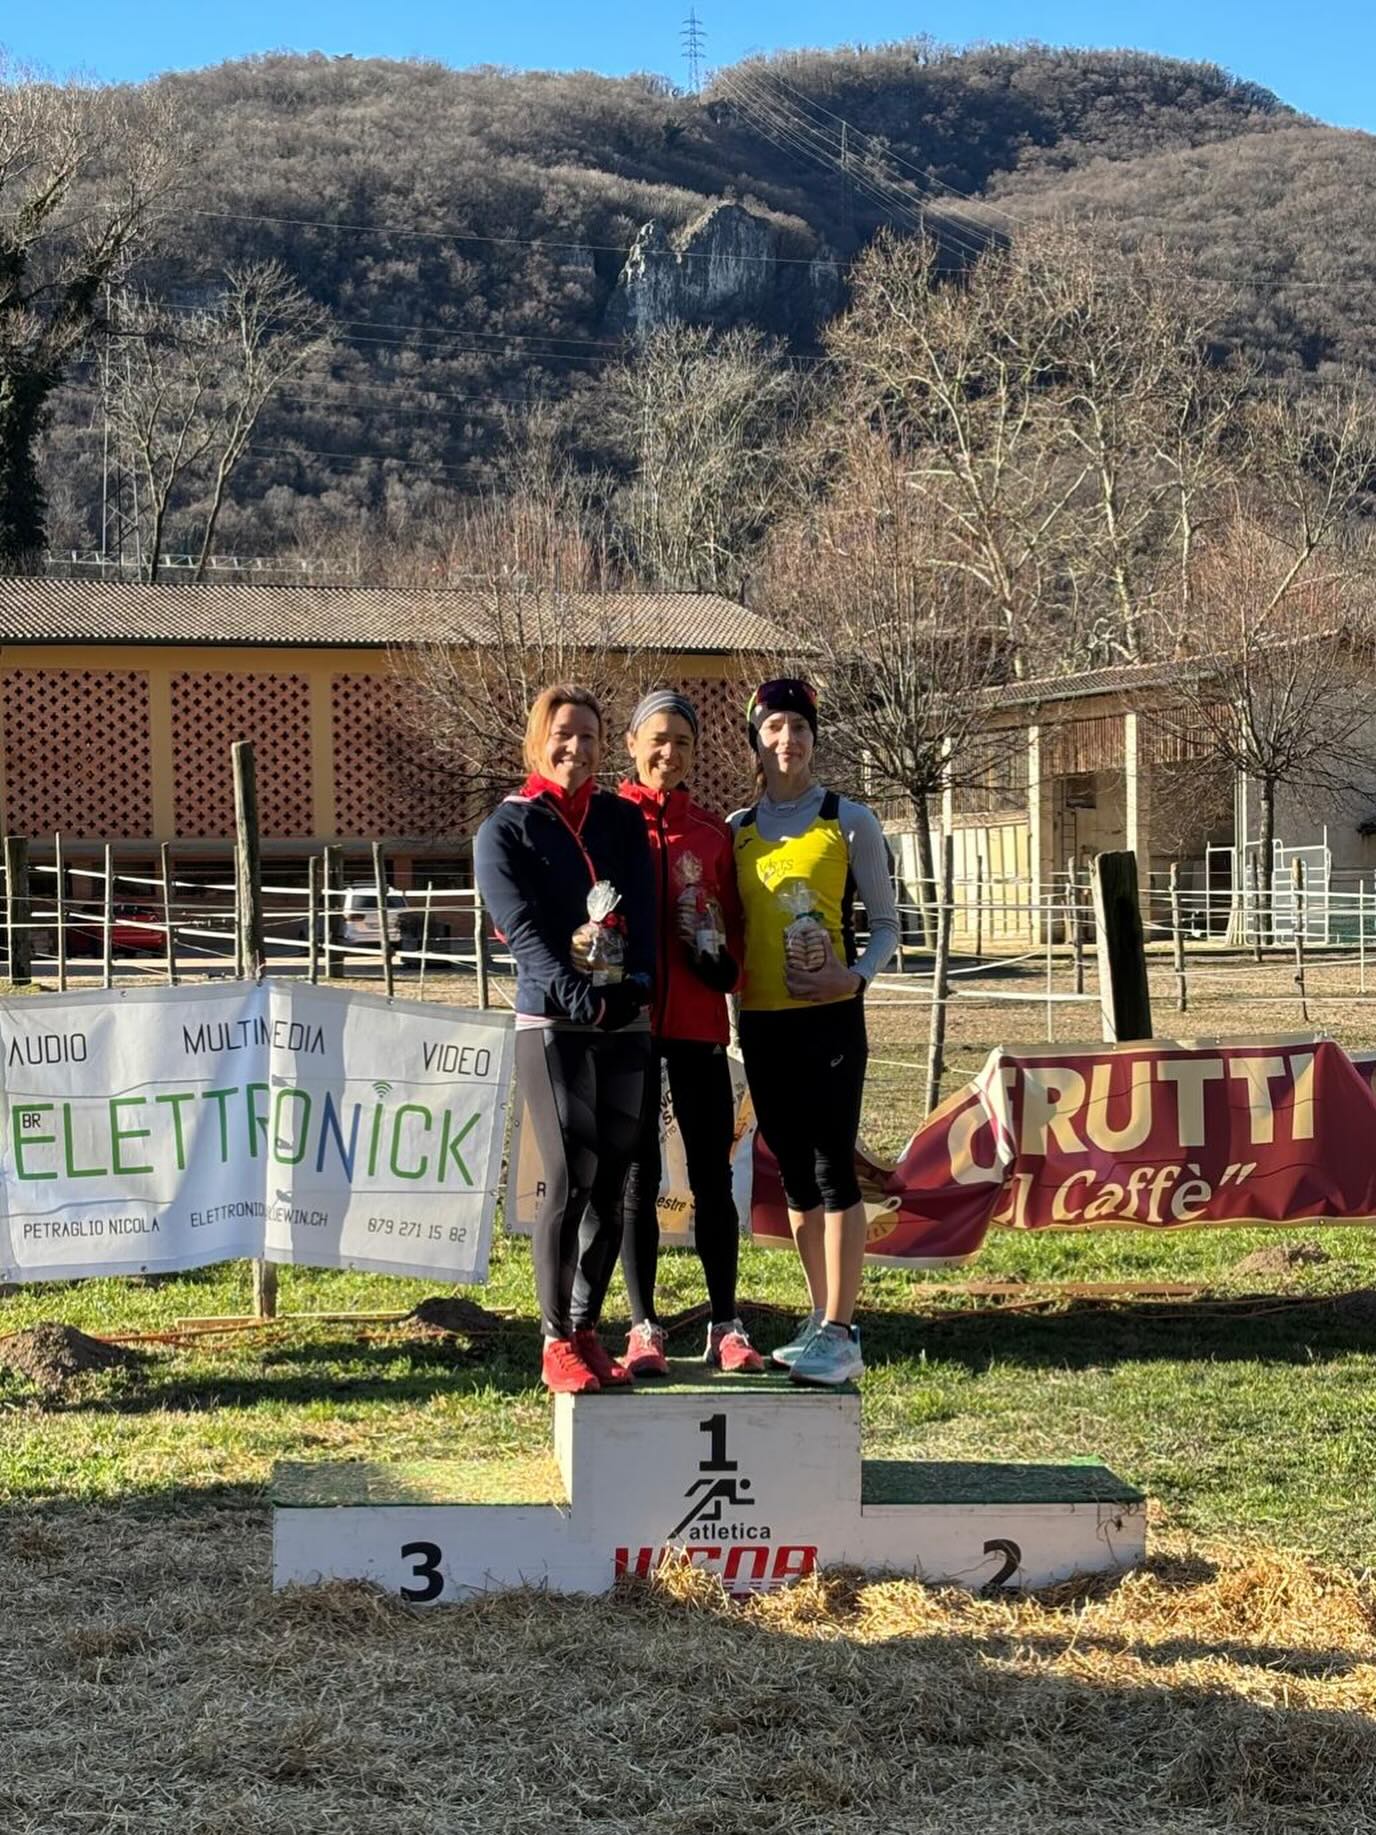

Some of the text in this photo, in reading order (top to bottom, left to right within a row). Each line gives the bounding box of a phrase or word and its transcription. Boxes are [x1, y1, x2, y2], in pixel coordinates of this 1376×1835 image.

[9, 1033, 87, 1067] AUDIO
[423, 1041, 490, 1077] VIDEO
[12, 1082, 481, 1186] ELETTRONICK
[22, 1113, 41, 1128] BR
[24, 1218, 160, 1239] PETRAGLIO NICOLA
[399, 1221, 421, 1238] 271
[428, 1225, 443, 1240] 15
[449, 1227, 467, 1243] 82
[699, 1413, 738, 1472] 1
[689, 1523, 771, 1540] atletica
[400, 1541, 444, 1602] 3
[981, 1539, 1021, 1593] 2
